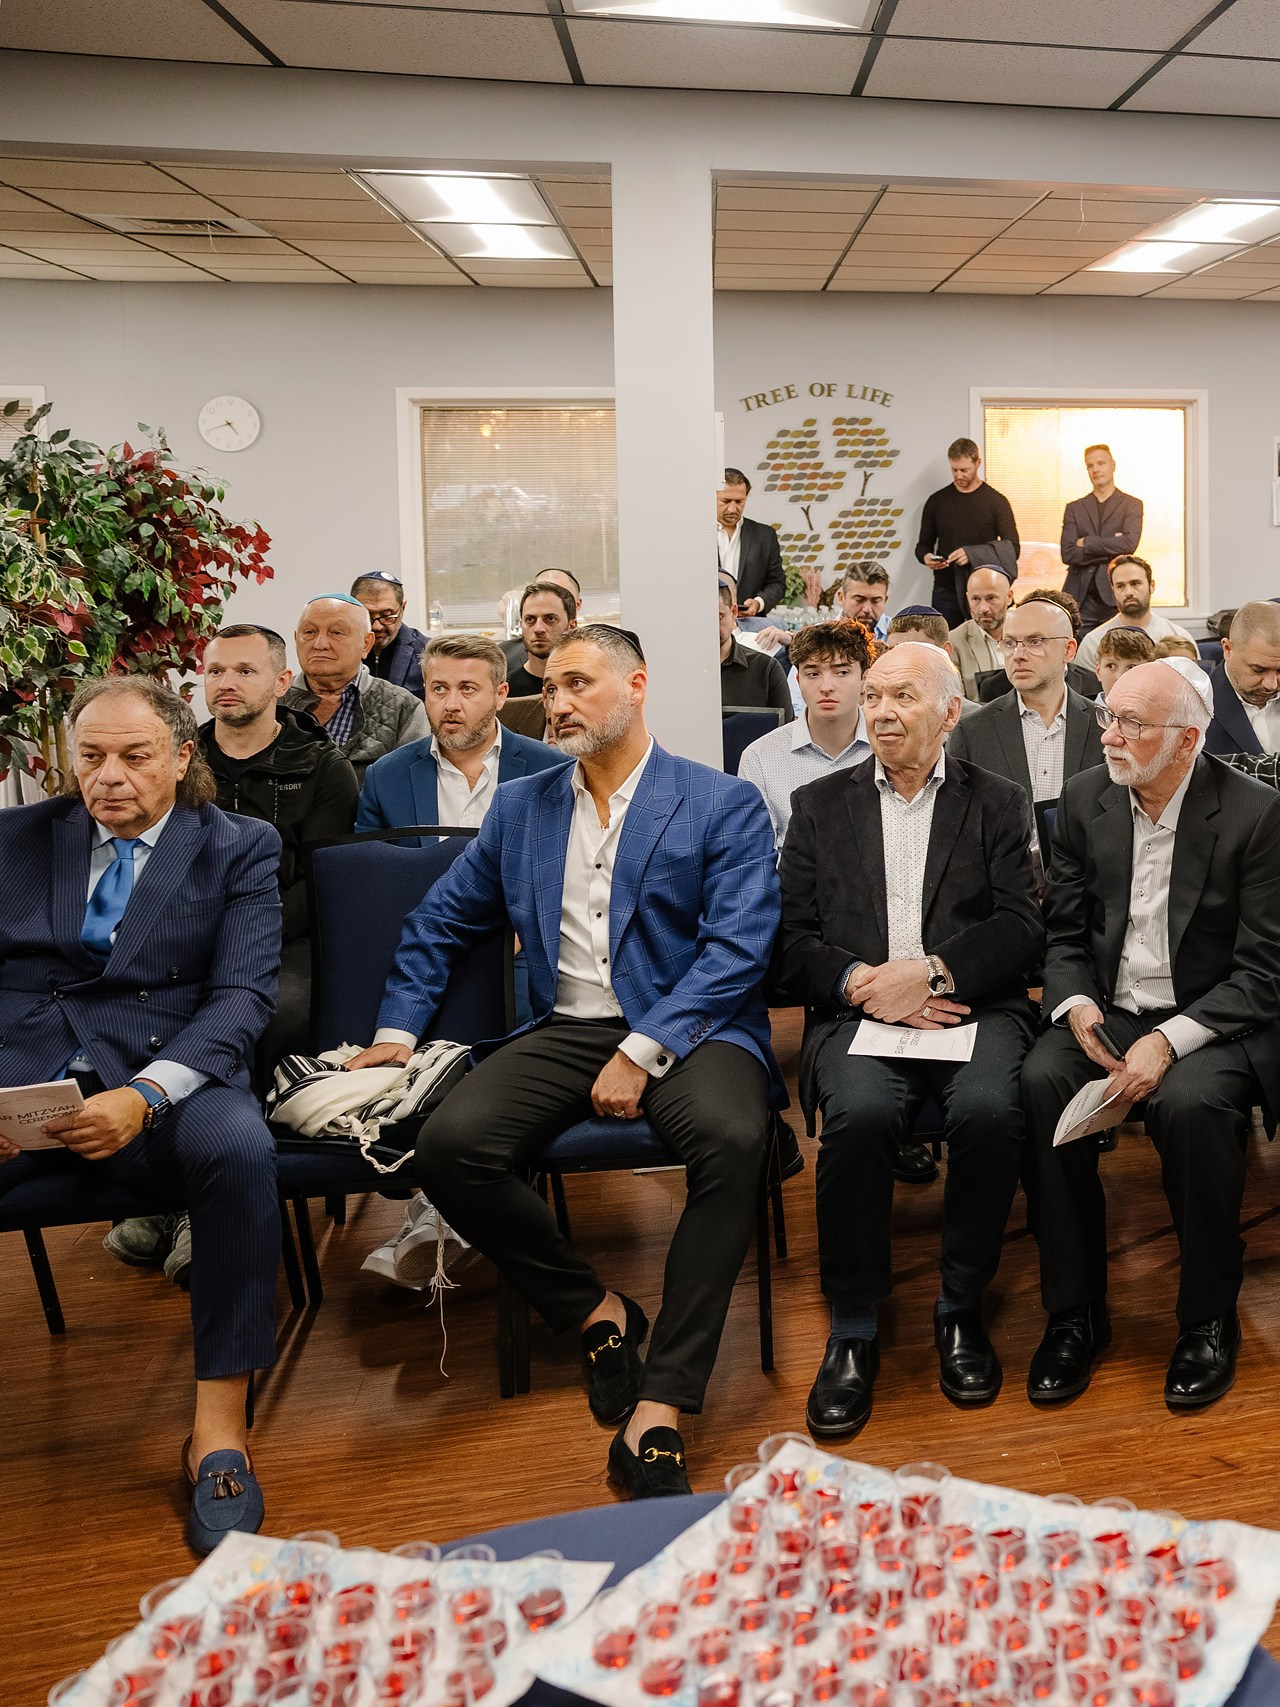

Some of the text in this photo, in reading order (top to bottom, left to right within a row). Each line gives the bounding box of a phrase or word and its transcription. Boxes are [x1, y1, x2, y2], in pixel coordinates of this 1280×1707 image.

[739, 382, 894, 412] TREE OF LIFE
[17, 1105, 76, 1119] MITZVAH
[19, 1109, 79, 1124] CEREMONY
